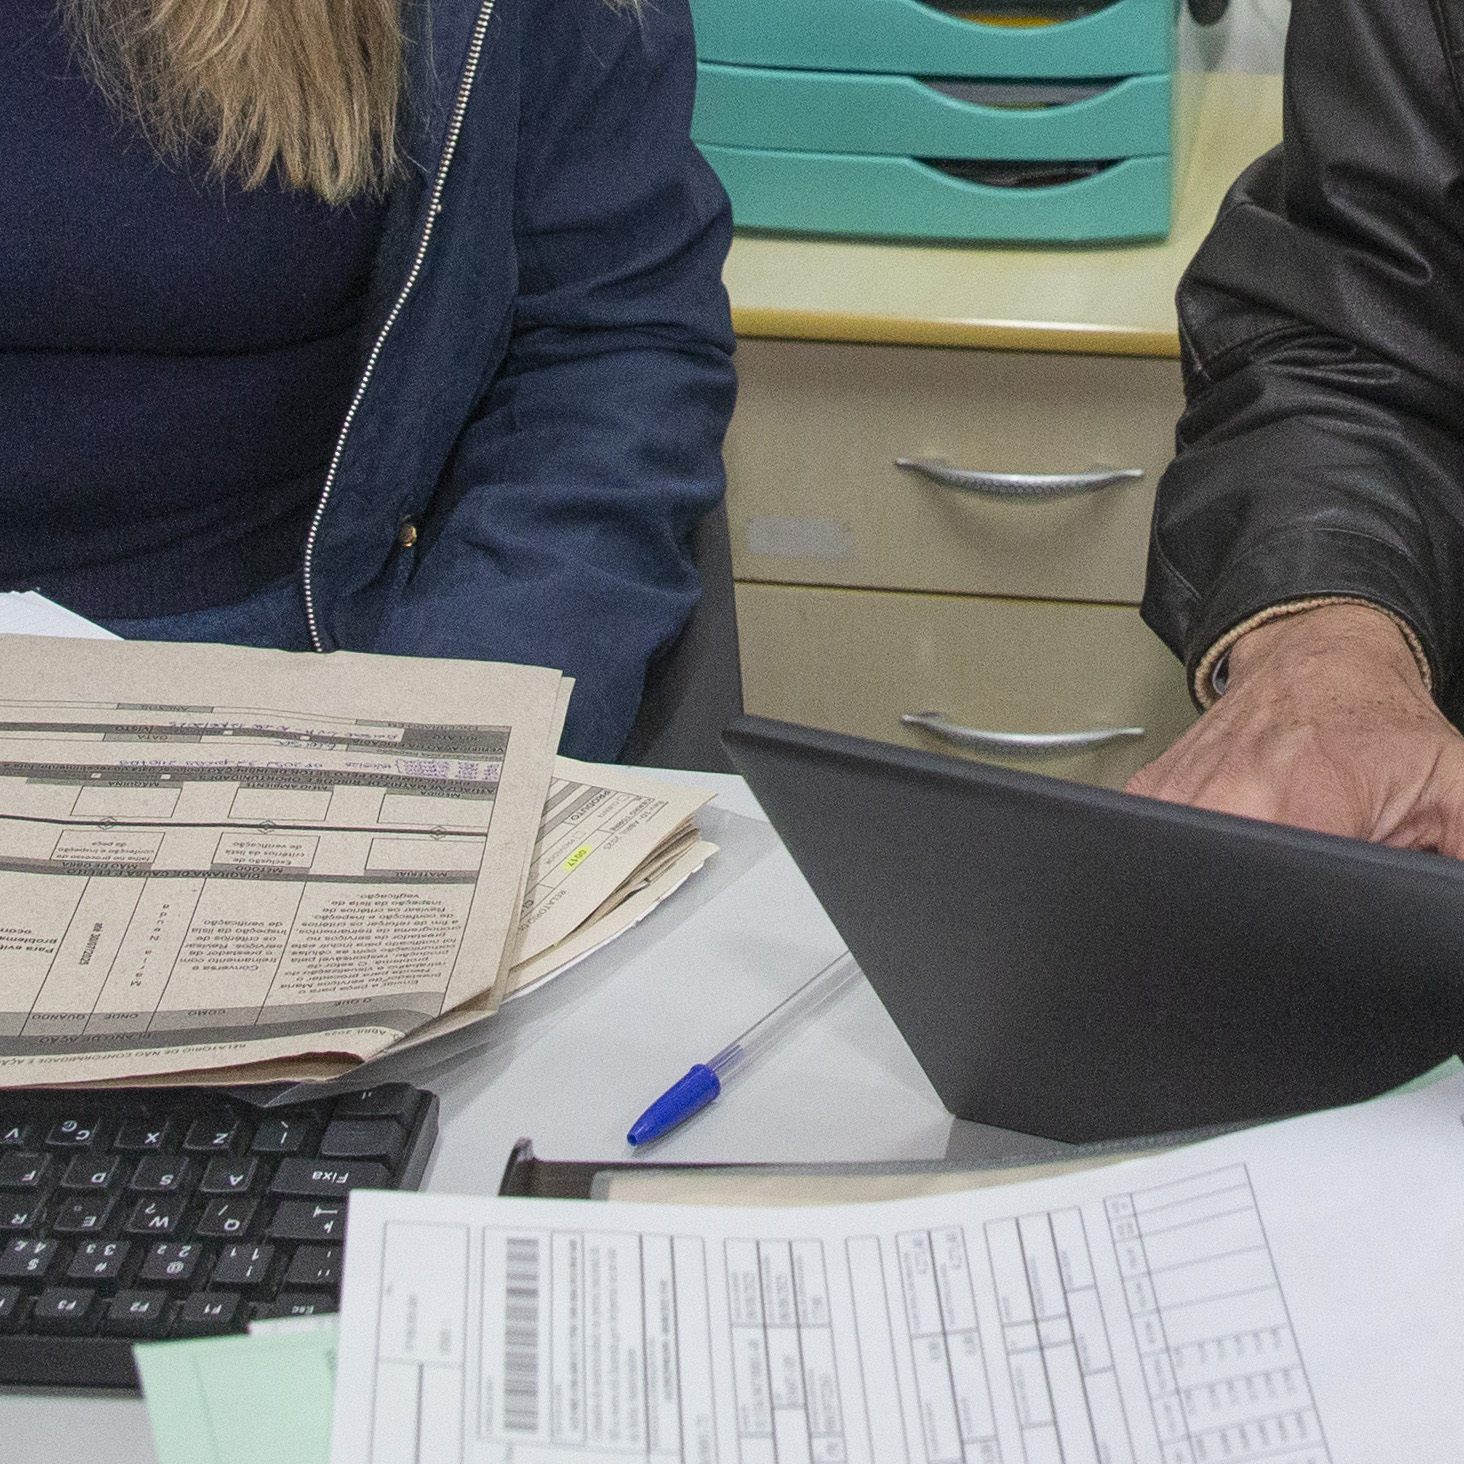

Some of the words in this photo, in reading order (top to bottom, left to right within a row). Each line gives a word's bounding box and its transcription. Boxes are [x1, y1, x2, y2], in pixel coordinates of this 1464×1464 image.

[570, 789, 610, 821] PRODUTO
[567, 849, 587, 867] 0017
[26, 943, 54, 954] Para
[5, 1127, 19, 1138] V
[75, 1130, 90, 1141] C
[145, 1132, 160, 1143] X
[213, 1133, 228, 1144] Z
[20, 1170, 36, 1181] F
[90, 1172, 107, 1183] D
[158, 1174, 174, 1185] S
[229, 1174, 244, 1186] A
[312, 1170, 349, 1184] Fixa
[11, 1214, 27, 1224] R
[81, 1215, 97, 1227] E
[149, 1215, 169, 1228] W
[224, 1218, 240, 1231] Q
[57, 1300, 77, 1310] F3
[130, 1301, 150, 1312] F2
[203, 1303, 222, 1314] F1
